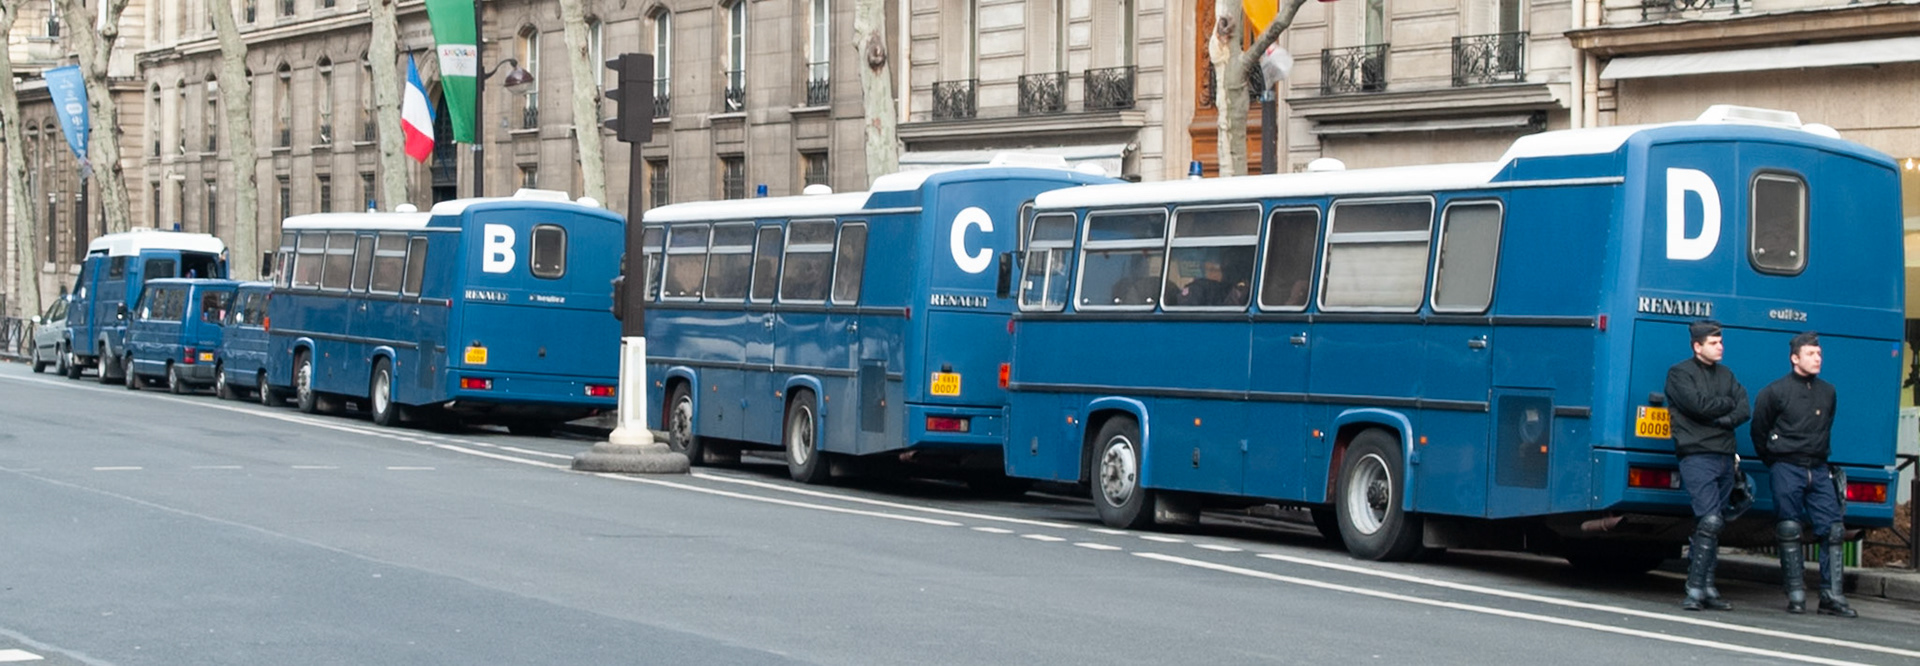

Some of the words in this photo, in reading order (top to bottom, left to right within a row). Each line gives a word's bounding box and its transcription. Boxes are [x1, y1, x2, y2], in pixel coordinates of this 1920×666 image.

[1666, 168, 1722, 261] D
[482, 223, 516, 274] B
[950, 206, 994, 274] C
[465, 289, 509, 301] RENAULT
[930, 293, 989, 308] RENAULT
[1637, 296, 1713, 317] RENAULT
[934, 383, 957, 394] 0007
[1640, 421, 1669, 436] 0009
